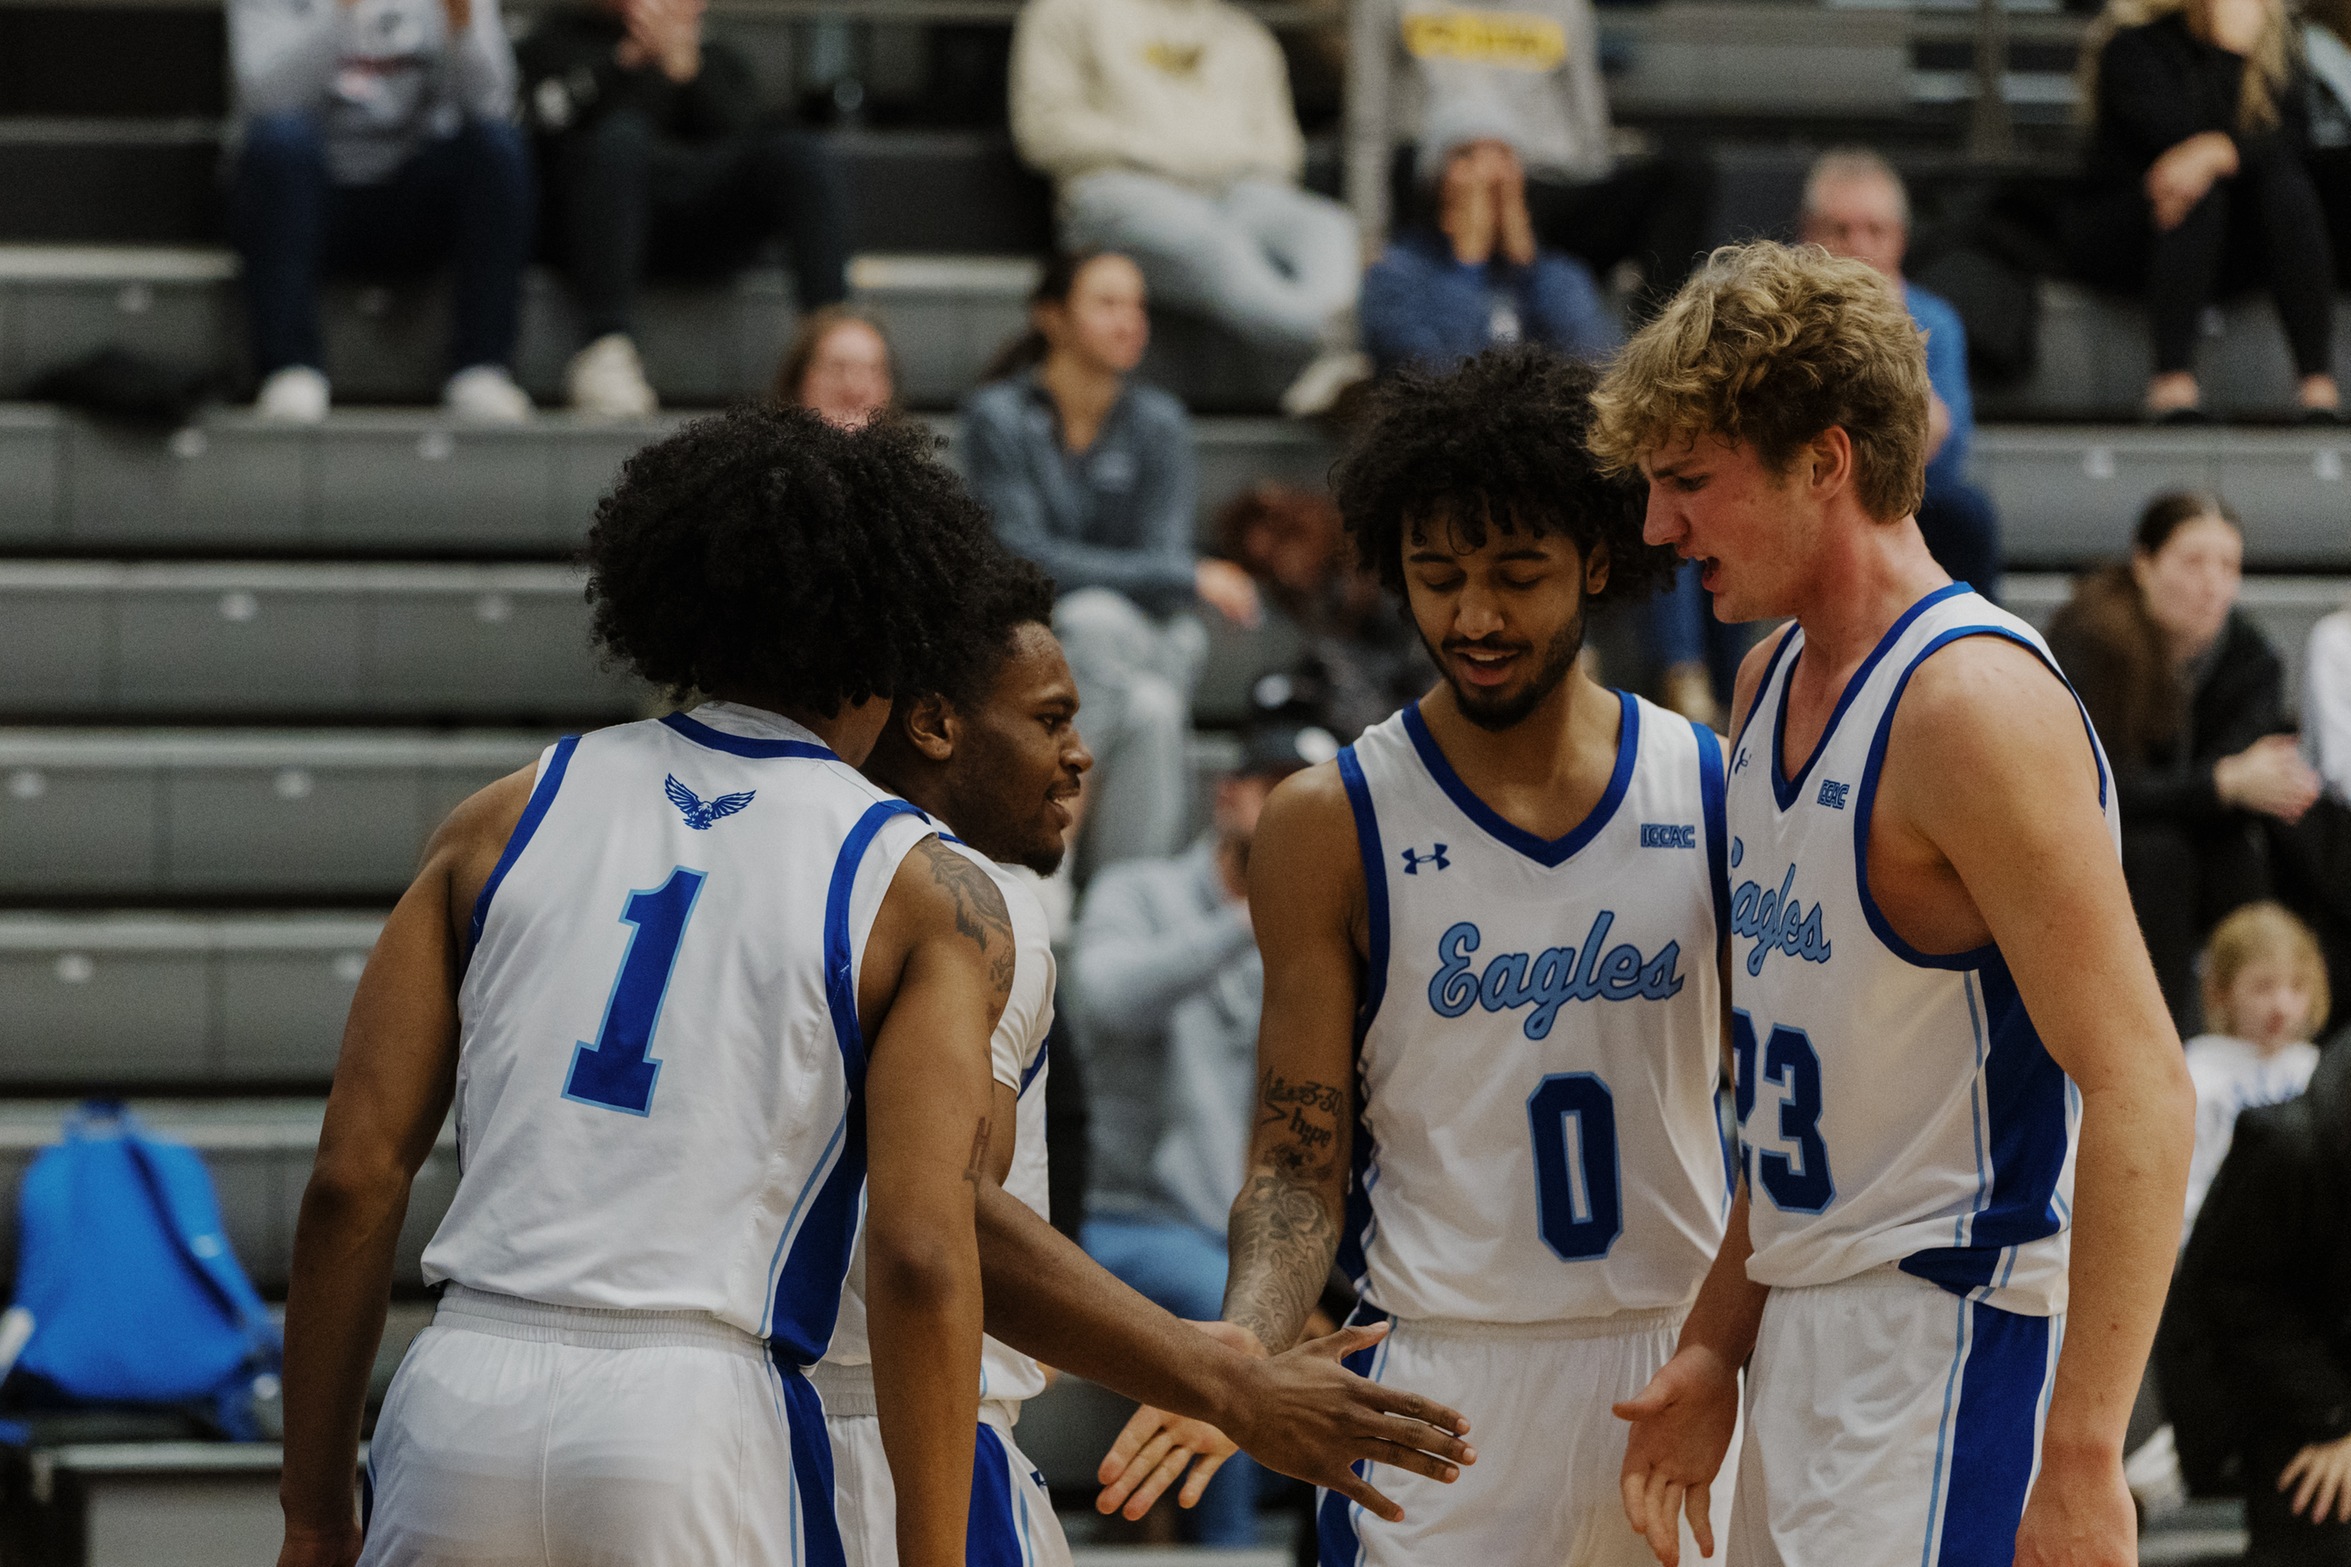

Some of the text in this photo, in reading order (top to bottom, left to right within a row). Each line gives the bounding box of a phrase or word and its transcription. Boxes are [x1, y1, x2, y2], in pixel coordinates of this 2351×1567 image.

[1428, 911, 1685, 1040] Eagles
[1730, 836, 1831, 976] agles
[560, 864, 708, 1118] 1
[1527, 1071, 1624, 1262] 0
